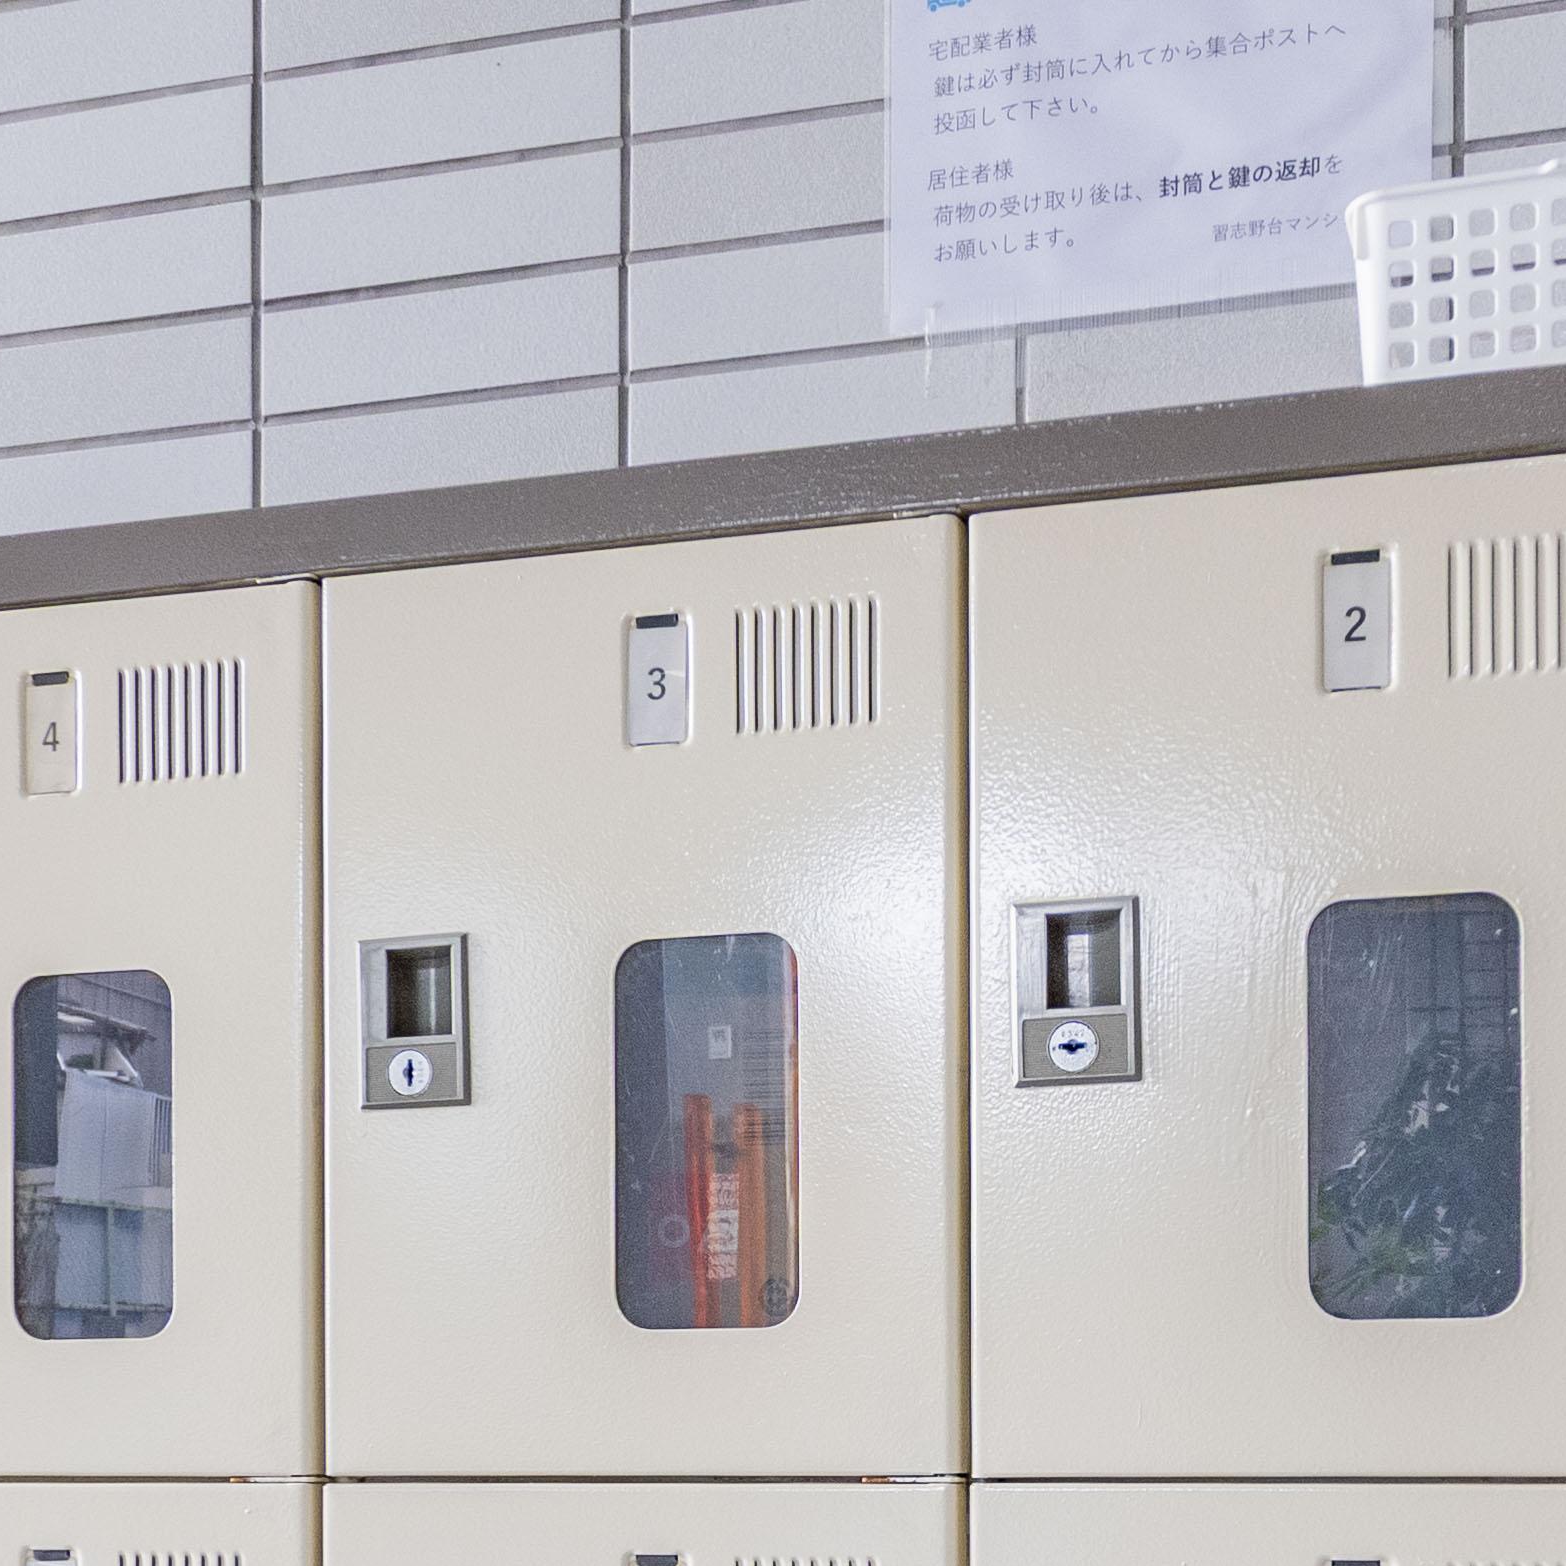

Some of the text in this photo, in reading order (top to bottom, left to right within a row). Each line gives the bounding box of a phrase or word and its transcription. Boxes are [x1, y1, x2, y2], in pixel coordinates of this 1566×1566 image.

[928, 24, 1038, 62] 宅配業者様
[933, 23, 1347, 98] 鍵は必ず封筒に入れてから集合ポストへ
[933, 96, 1099, 136] 投函して下さい。
[927, 158, 1015, 192] 居住者様
[933, 226, 1075, 264] お願いします。
[1344, 606, 1367, 643] 2
[647, 667, 667, 701] 3
[42, 721, 60, 752] 4
